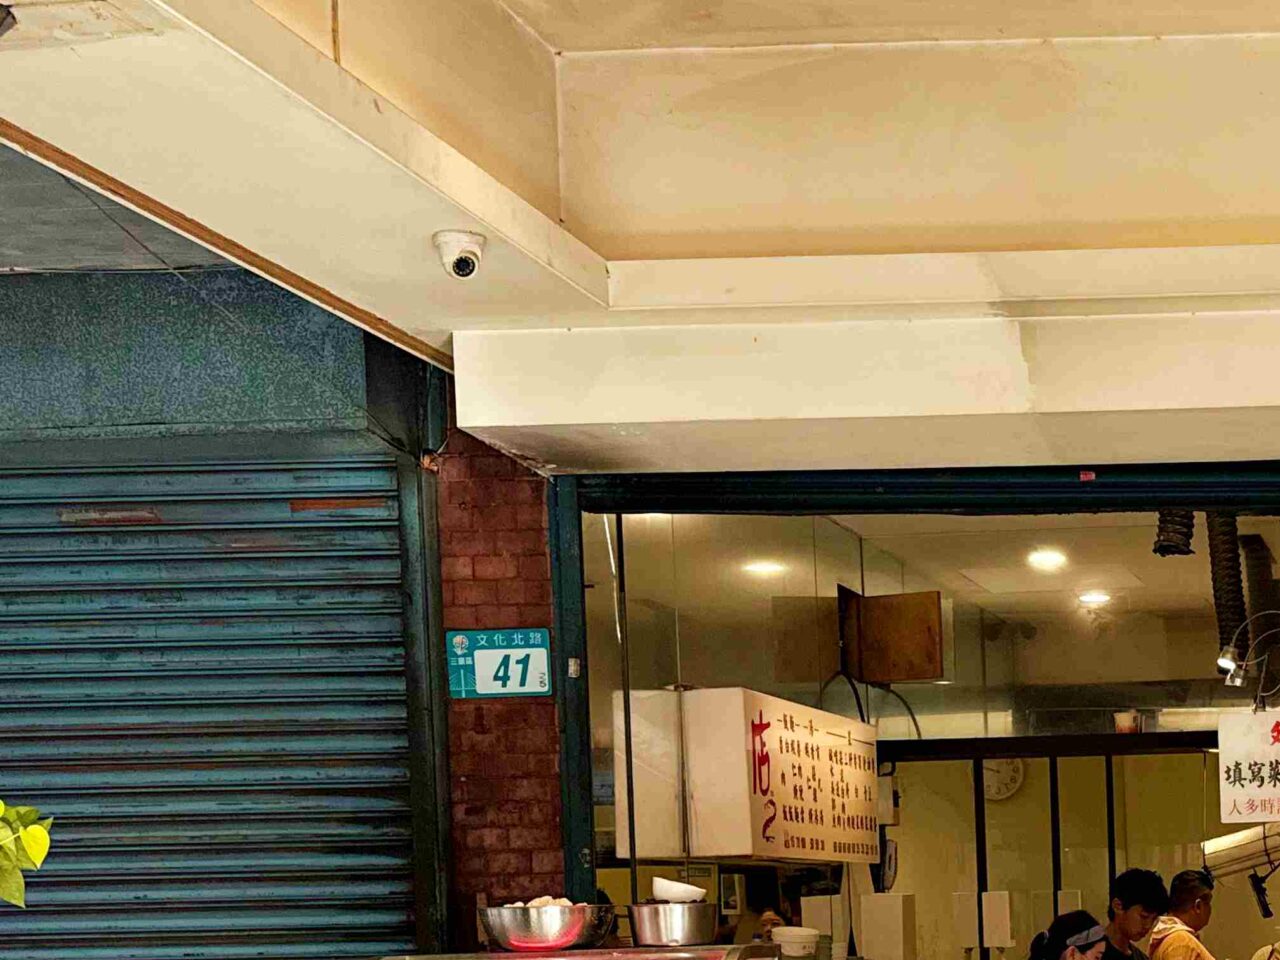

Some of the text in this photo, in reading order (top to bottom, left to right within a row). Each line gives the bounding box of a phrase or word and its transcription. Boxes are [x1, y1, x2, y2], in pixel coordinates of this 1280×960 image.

[475, 632, 542, 646] 文化北路
[493, 653, 531, 688] 41
